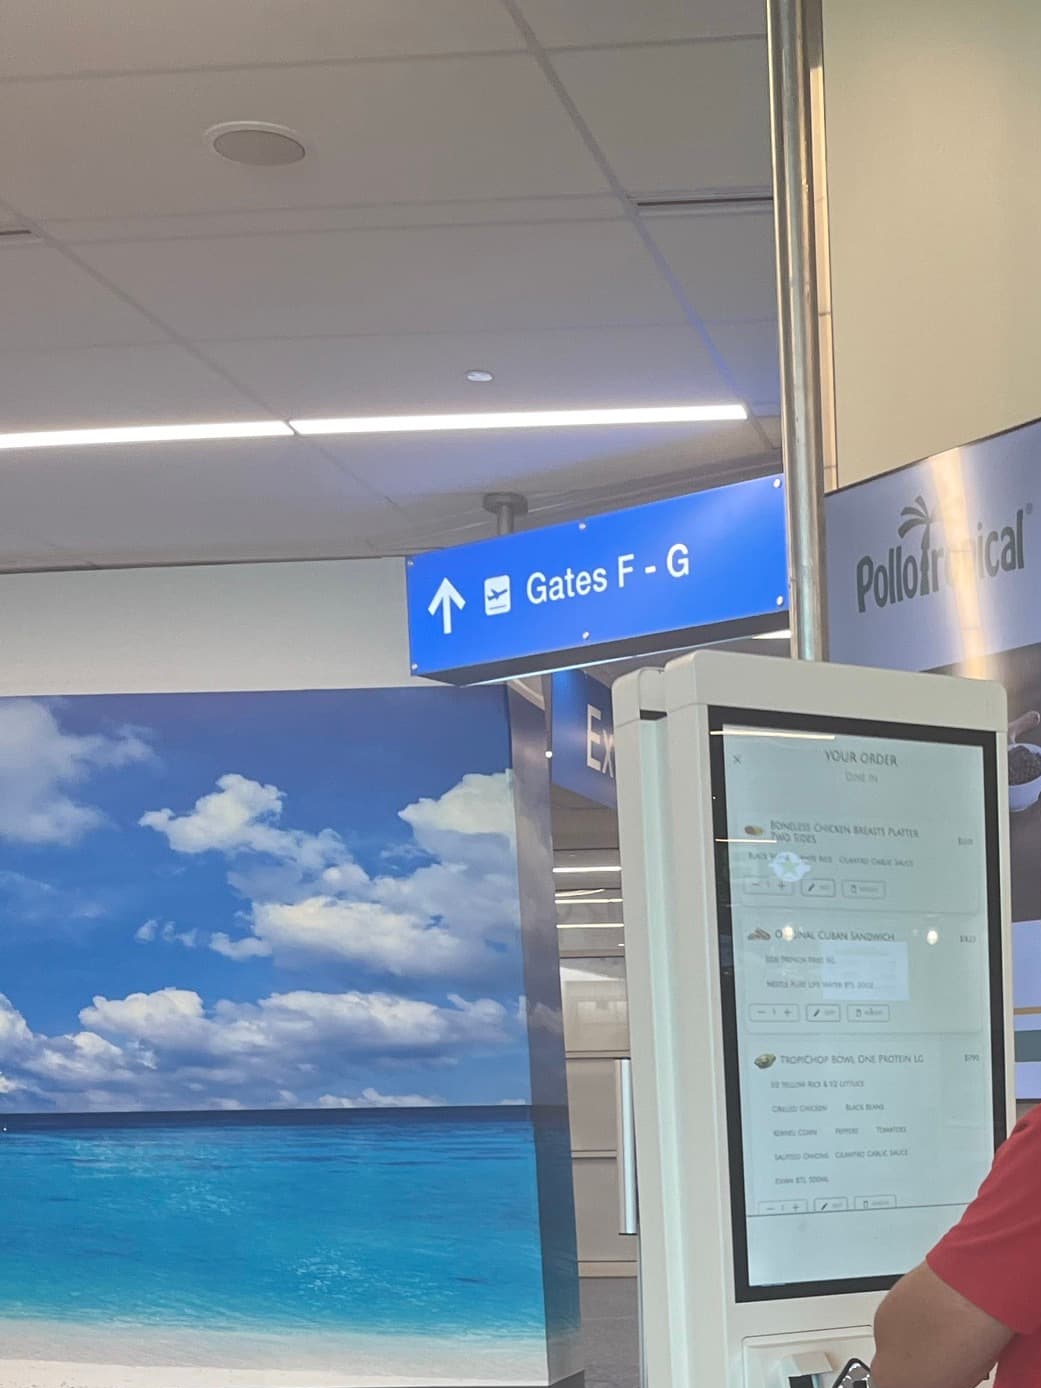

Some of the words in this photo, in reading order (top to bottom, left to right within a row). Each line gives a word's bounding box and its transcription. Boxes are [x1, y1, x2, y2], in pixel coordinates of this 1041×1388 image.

[526, 567, 608, 605] Gates
[617, 553, 635, 588] F
[666, 543, 690, 578] G
[824, 749, 857, 763] YOUR
[860, 752, 898, 767] ORDER
[817, 930, 848, 941] CUBAN
[850, 931, 895, 942] SANDWICH
[831, 1055, 855, 1064] BOWL
[857, 1054, 877, 1064] ONE
[878, 1054, 912, 1064] PROTEIN
